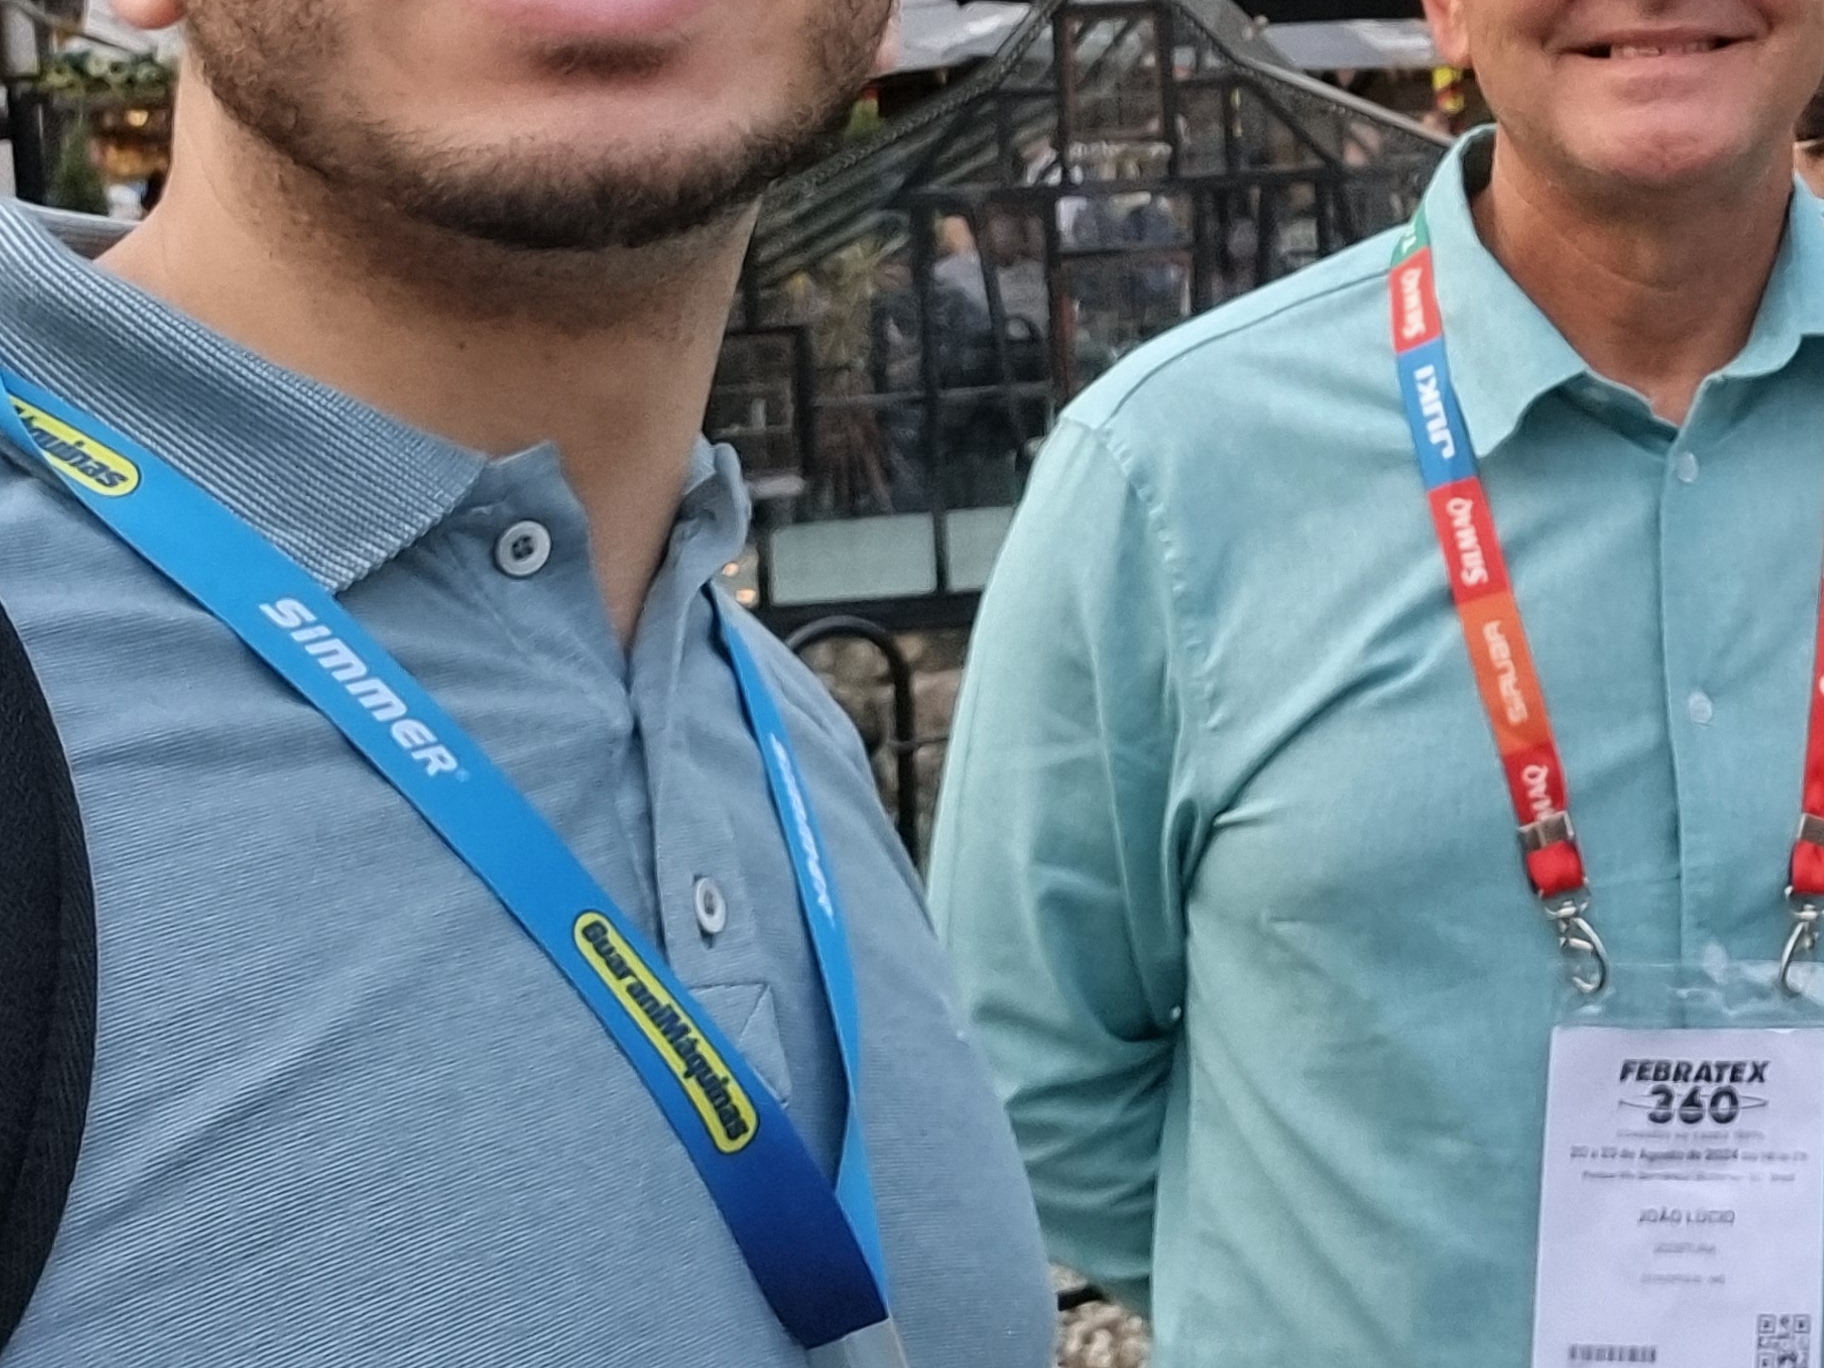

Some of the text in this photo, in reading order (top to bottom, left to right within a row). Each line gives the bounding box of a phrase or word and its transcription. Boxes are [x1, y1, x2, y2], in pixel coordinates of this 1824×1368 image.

[13, 404, 129, 489] quinas
[1412, 363, 1456, 461] JUKI
[1446, 495, 1490, 588] SILMAQ
[259, 596, 459, 777] SIMMER
[1520, 763, 1554, 823] MAQ
[1619, 1058, 1771, 1083] FEBRATEX
[1647, 1083, 1739, 1124] 360
